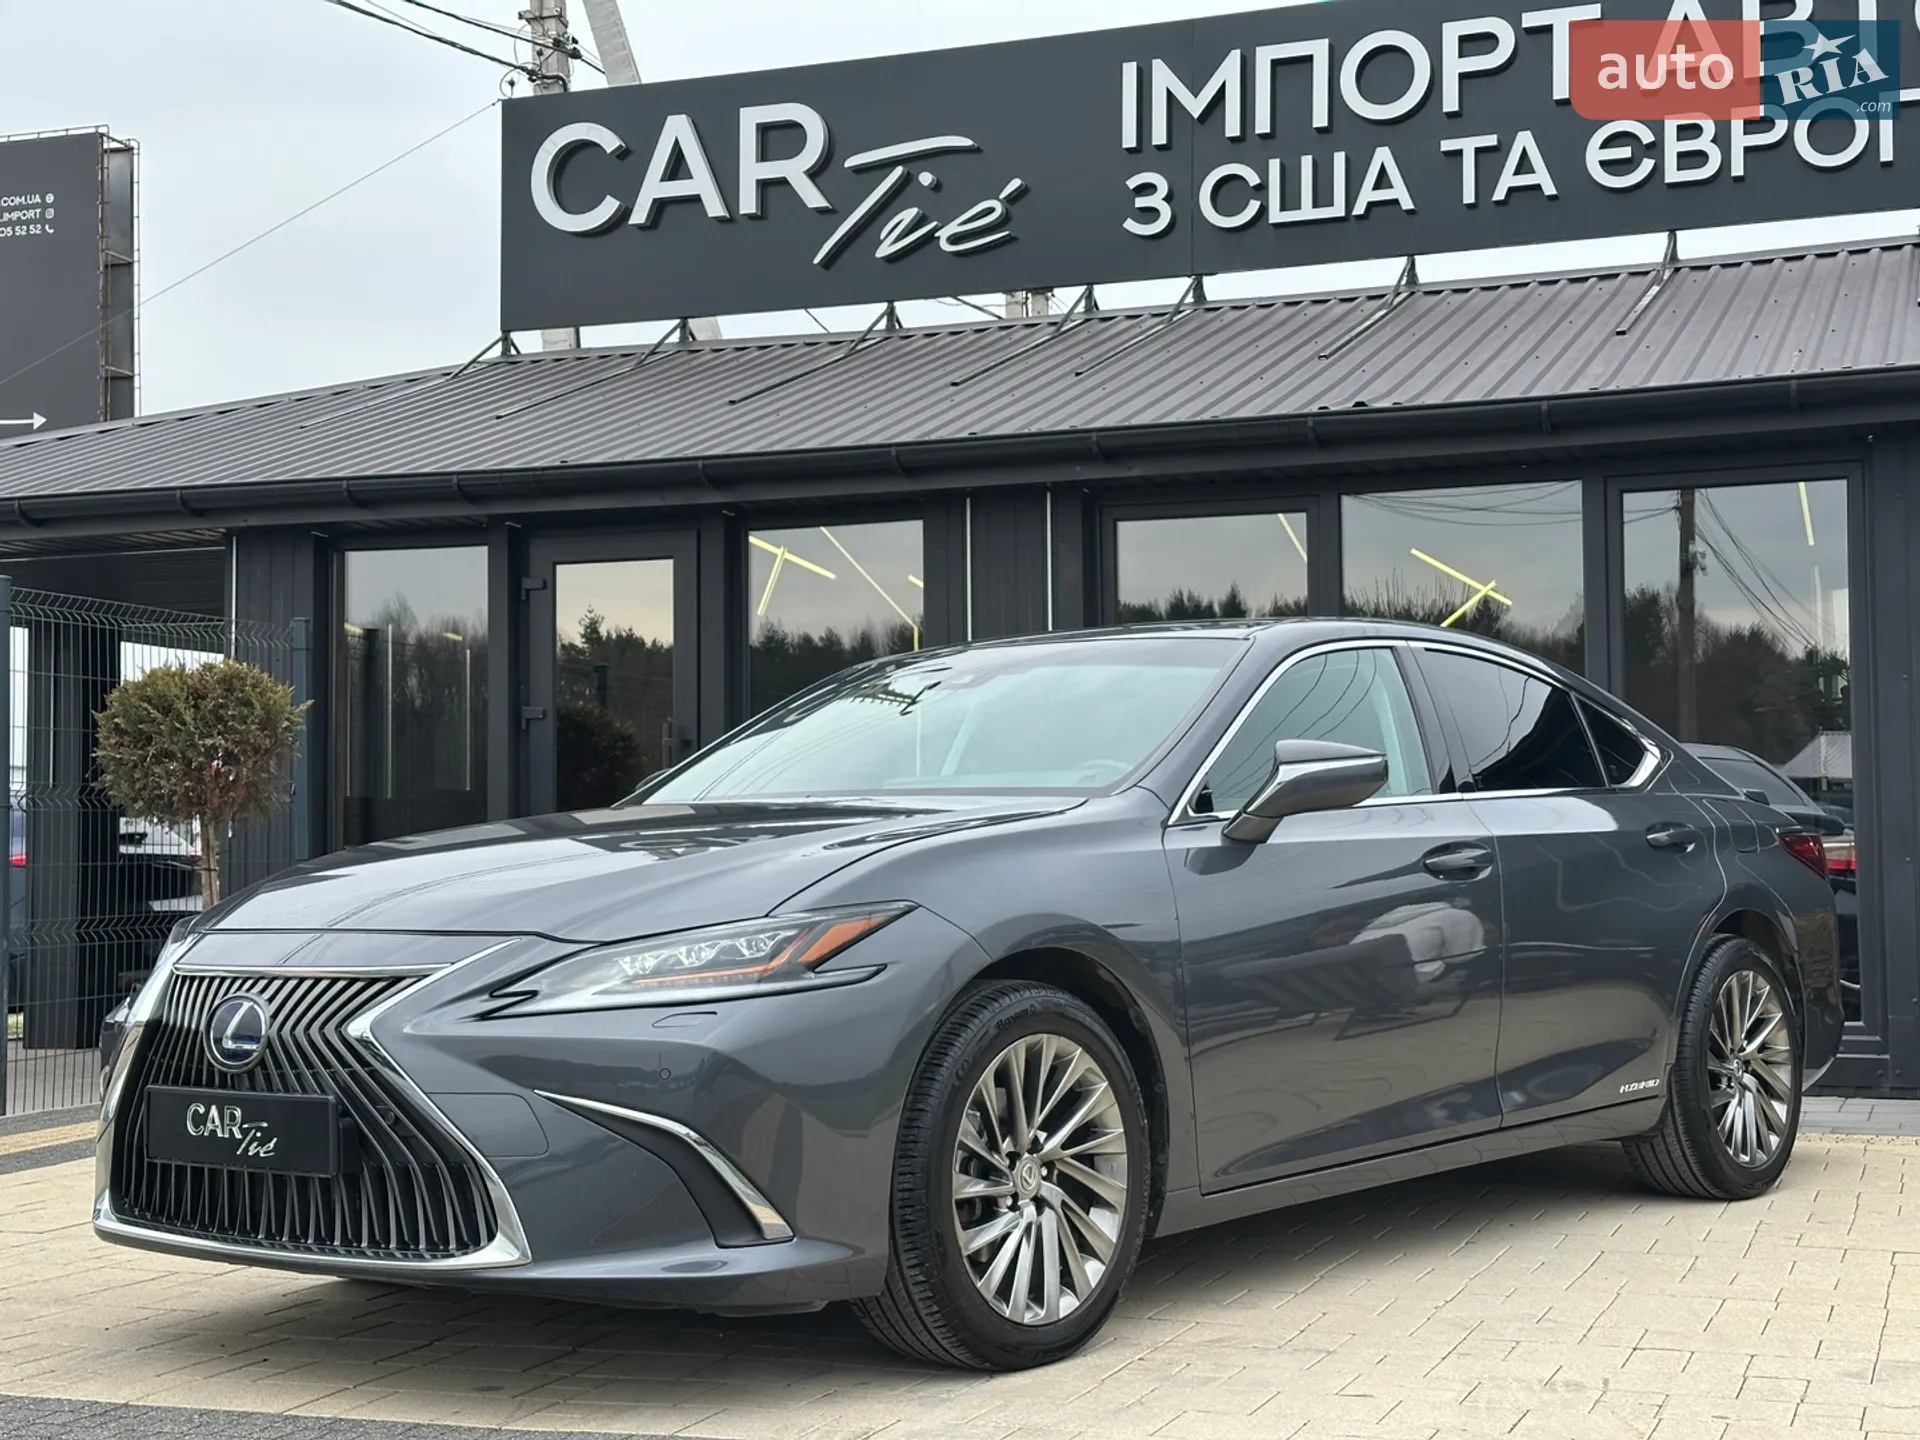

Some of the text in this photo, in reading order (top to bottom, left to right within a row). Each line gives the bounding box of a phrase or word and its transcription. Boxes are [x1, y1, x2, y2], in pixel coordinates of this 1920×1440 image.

[1122, 3, 1601, 149] ІМПОРТ
[530, 102, 835, 234] CAR
[1199, 146, 1415, 228] США
[1440, 130, 1559, 204] ТА
[15, 225, 27, 236] 52
[29, 223, 42, 235] 52
[186, 1102, 243, 1138] CAR
